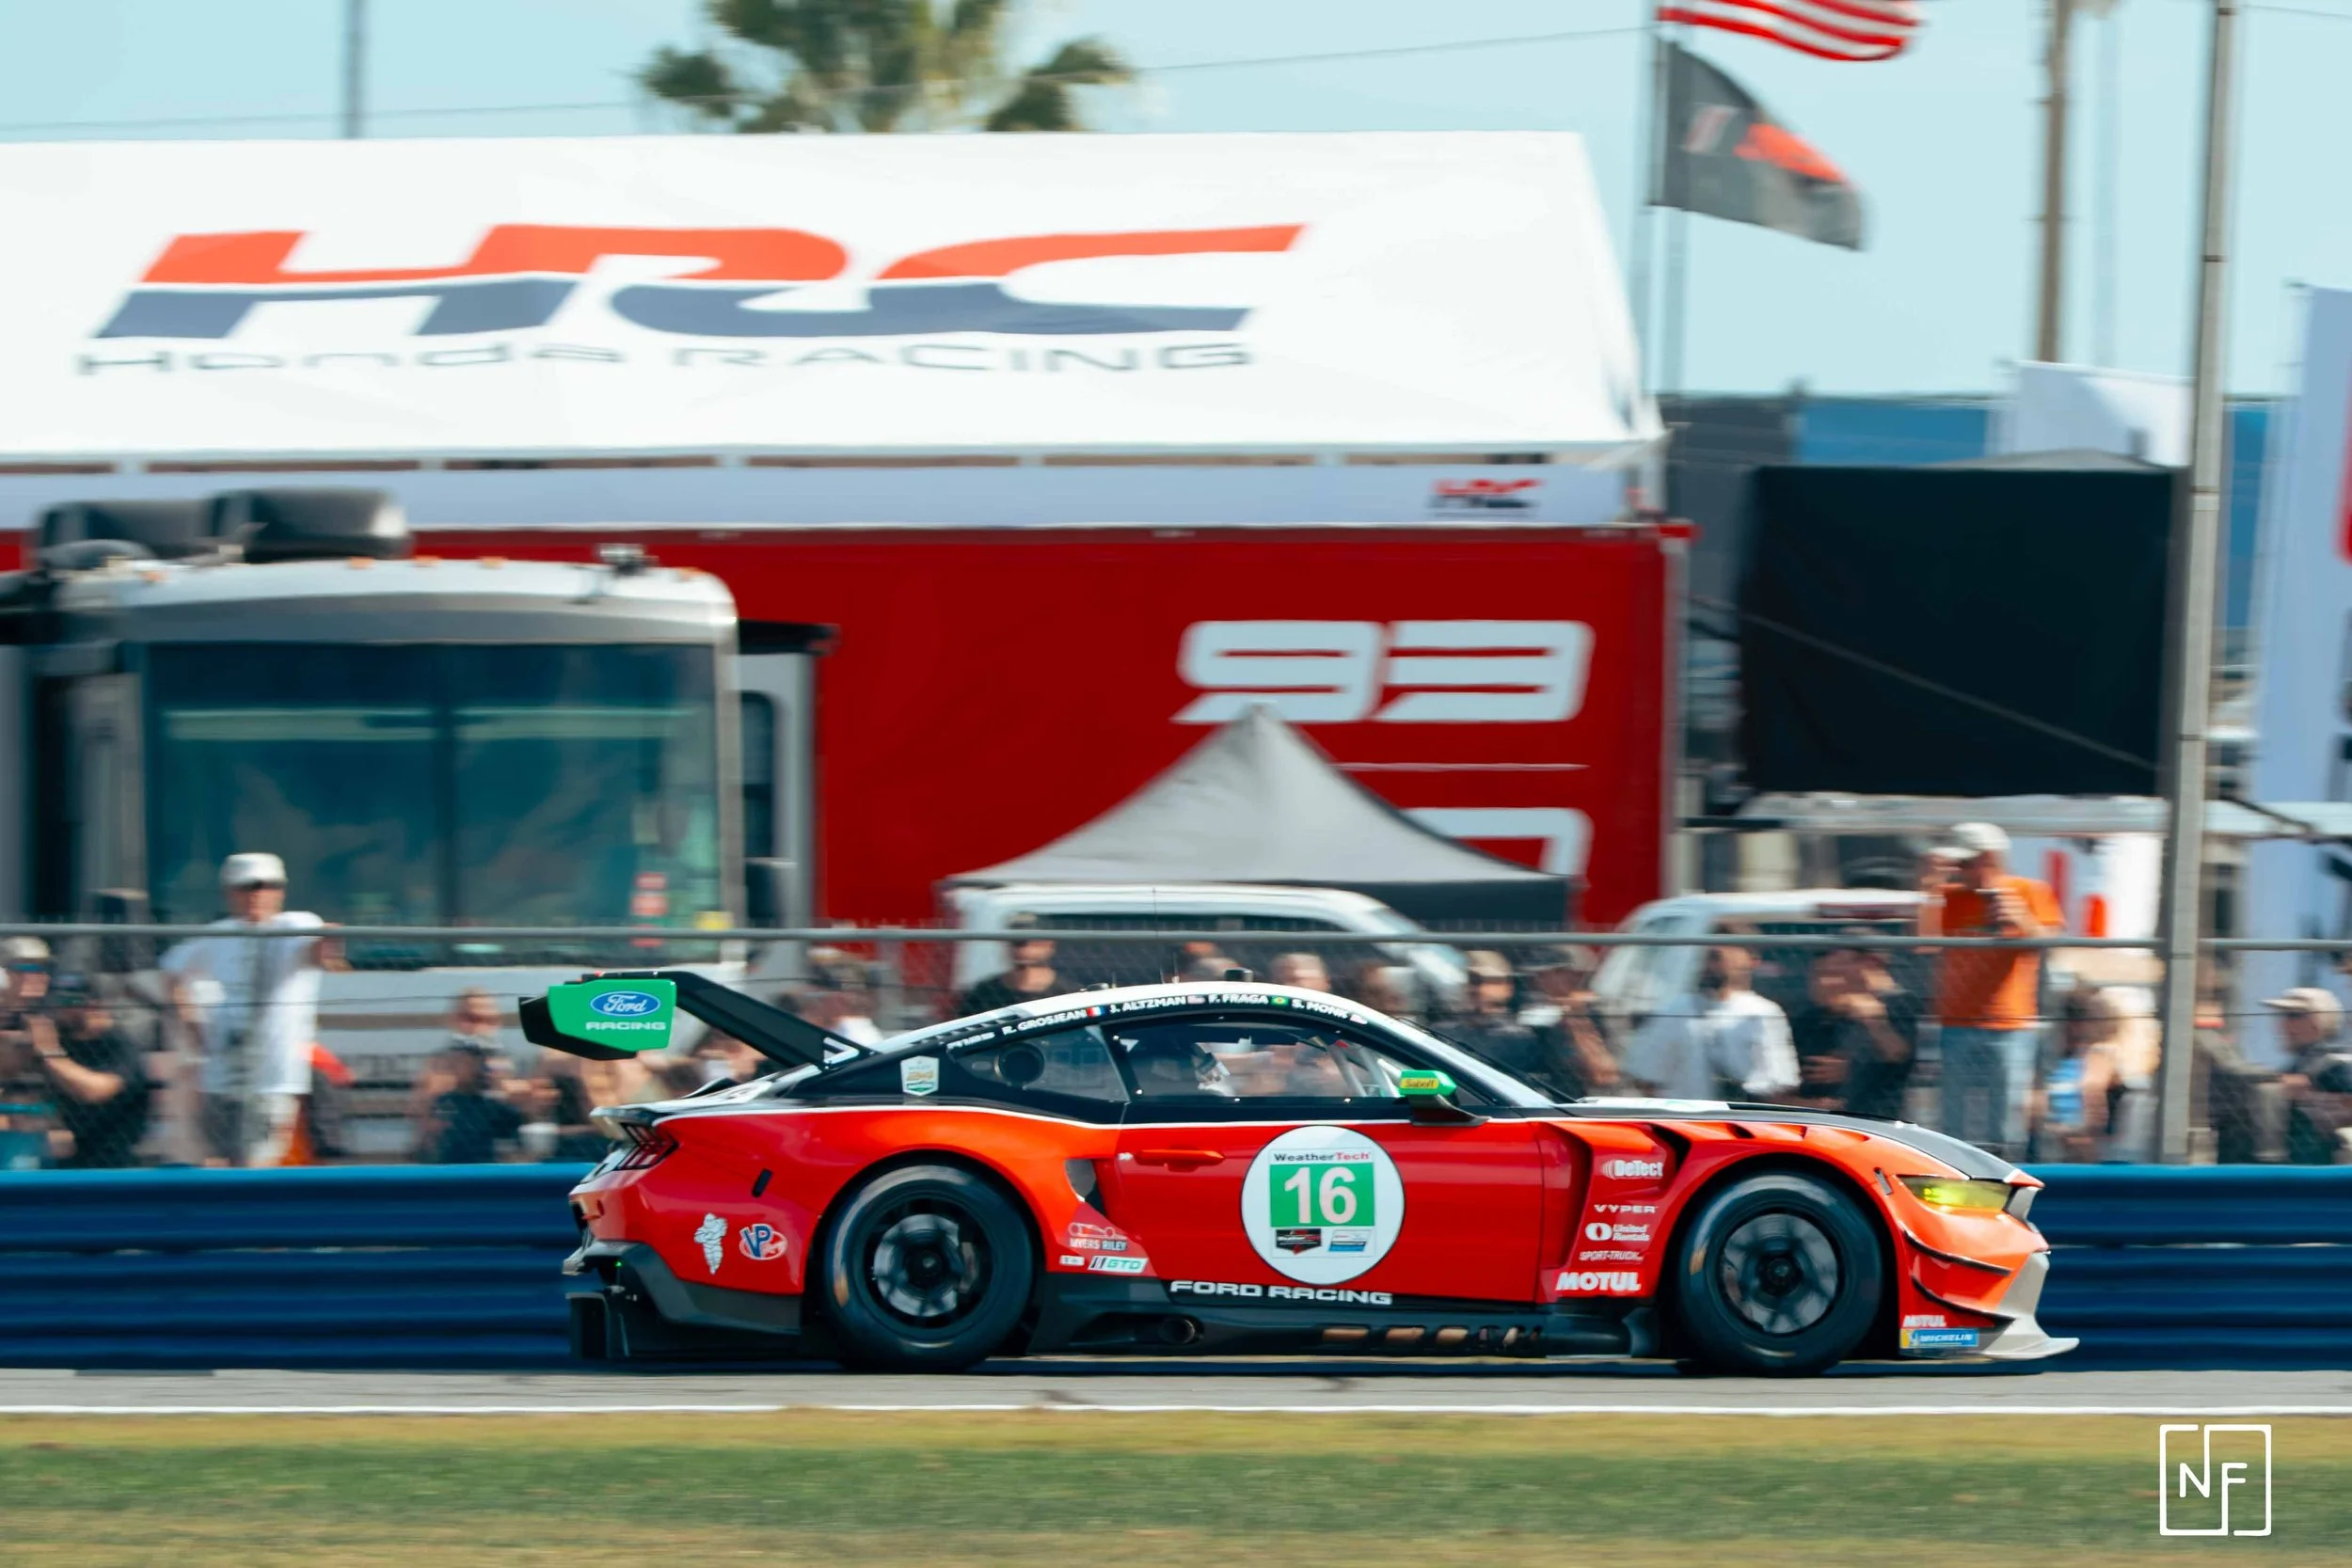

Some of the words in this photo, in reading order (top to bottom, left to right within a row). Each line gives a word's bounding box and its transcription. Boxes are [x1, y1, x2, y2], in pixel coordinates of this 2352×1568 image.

[91, 221, 1308, 338] HRC
[668, 341, 1253, 372] RACING
[1169, 619, 1596, 723] 93
[602, 993, 648, 1013] Ford
[1109, 1004, 1120, 1013] J.
[1121, 996, 1186, 1013] ALTZMAN
[1222, 993, 1269, 1005] FRAGA
[1306, 1000, 1350, 1020] MONK
[585, 1022, 667, 1031] RACING
[1017, 1009, 1087, 1032] GROSJEAN
[1274, 1151, 1370, 1162] WeatherTech
[1283, 1165, 1358, 1225] 16
[1594, 1204, 1657, 1213] VYPER
[739, 1223, 773, 1259] VP
[1102, 1240, 1127, 1251] RILEY
[1107, 1259, 1142, 1271] GTD
[1555, 1271, 1642, 1292] MOTUL
[1169, 1279, 1263, 1298] FORD
[1267, 1285, 1392, 1306] RACING
[1902, 1314, 1947, 1327] MOTUL
[1919, 1334, 1974, 1342] MICHELIN
